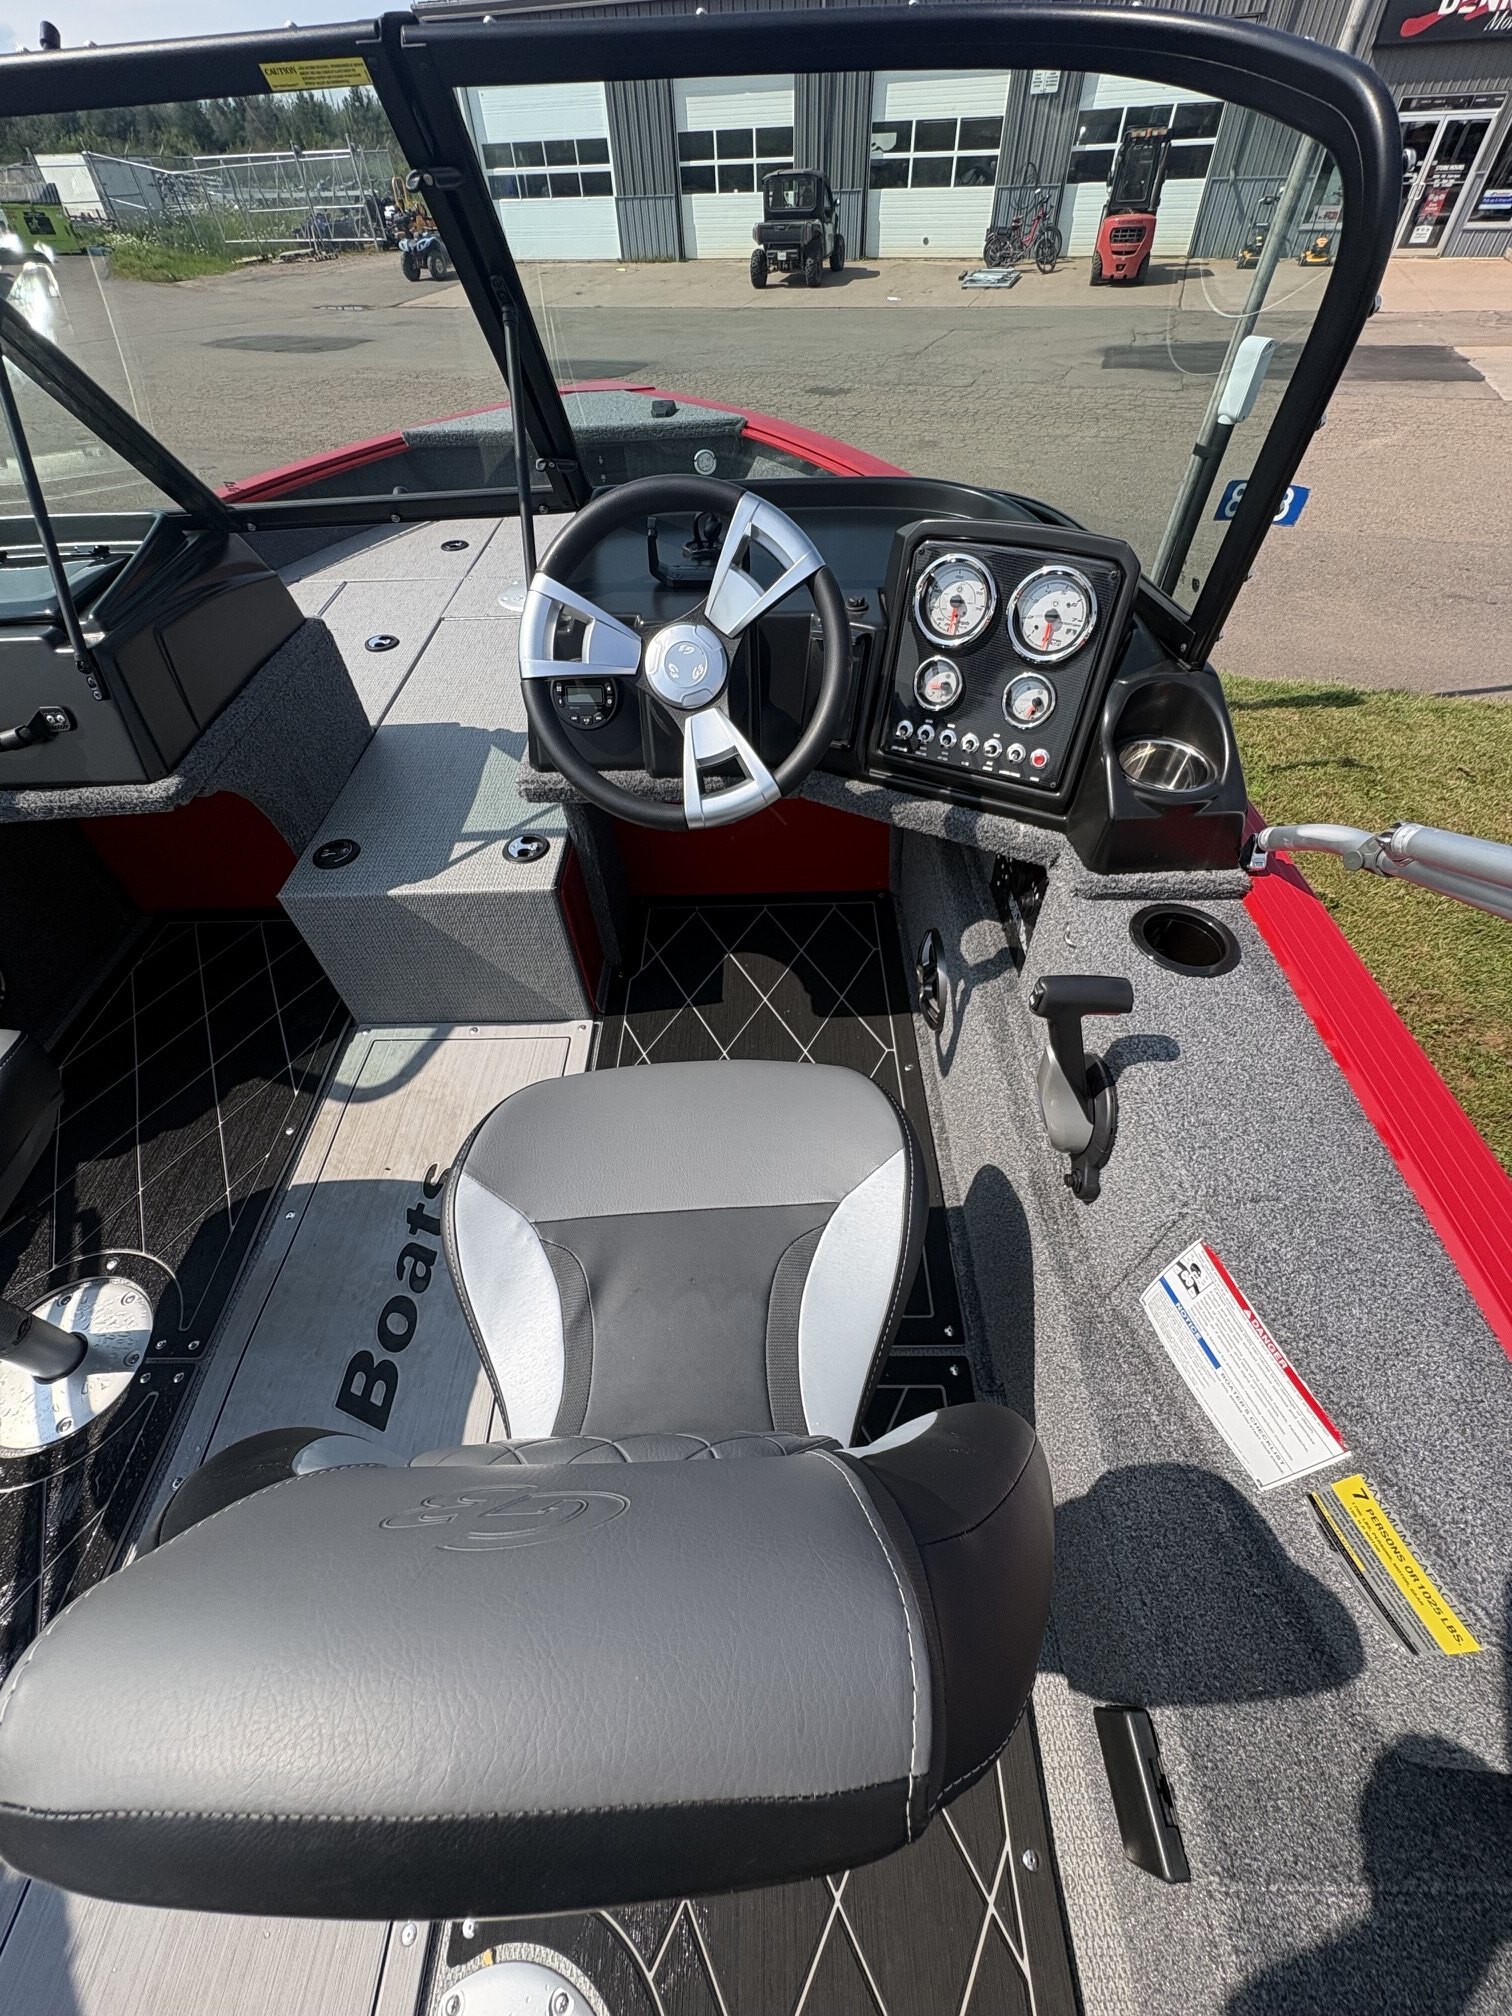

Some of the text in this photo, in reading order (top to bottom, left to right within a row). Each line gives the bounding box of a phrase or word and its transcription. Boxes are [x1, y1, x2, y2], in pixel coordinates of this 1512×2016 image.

[263, 66, 298, 77] CAUTION
[1174, 1301, 1202, 1341] NOTICE
[1250, 1318, 1288, 1369] DANGER
[1248, 1415, 1285, 1466] CHECKLIST
[1350, 1487, 1370, 1503] 7
[1364, 1508, 1407, 1562] PERSONS
[1403, 1565, 1420, 1582] OR
[1416, 1584, 1444, 1615] 1025
[1439, 1617, 1467, 1646] LBS.
[1361, 1475, 1413, 1547] MAXIMUM
[1409, 1550, 1485, 1645] CAPACITIES
